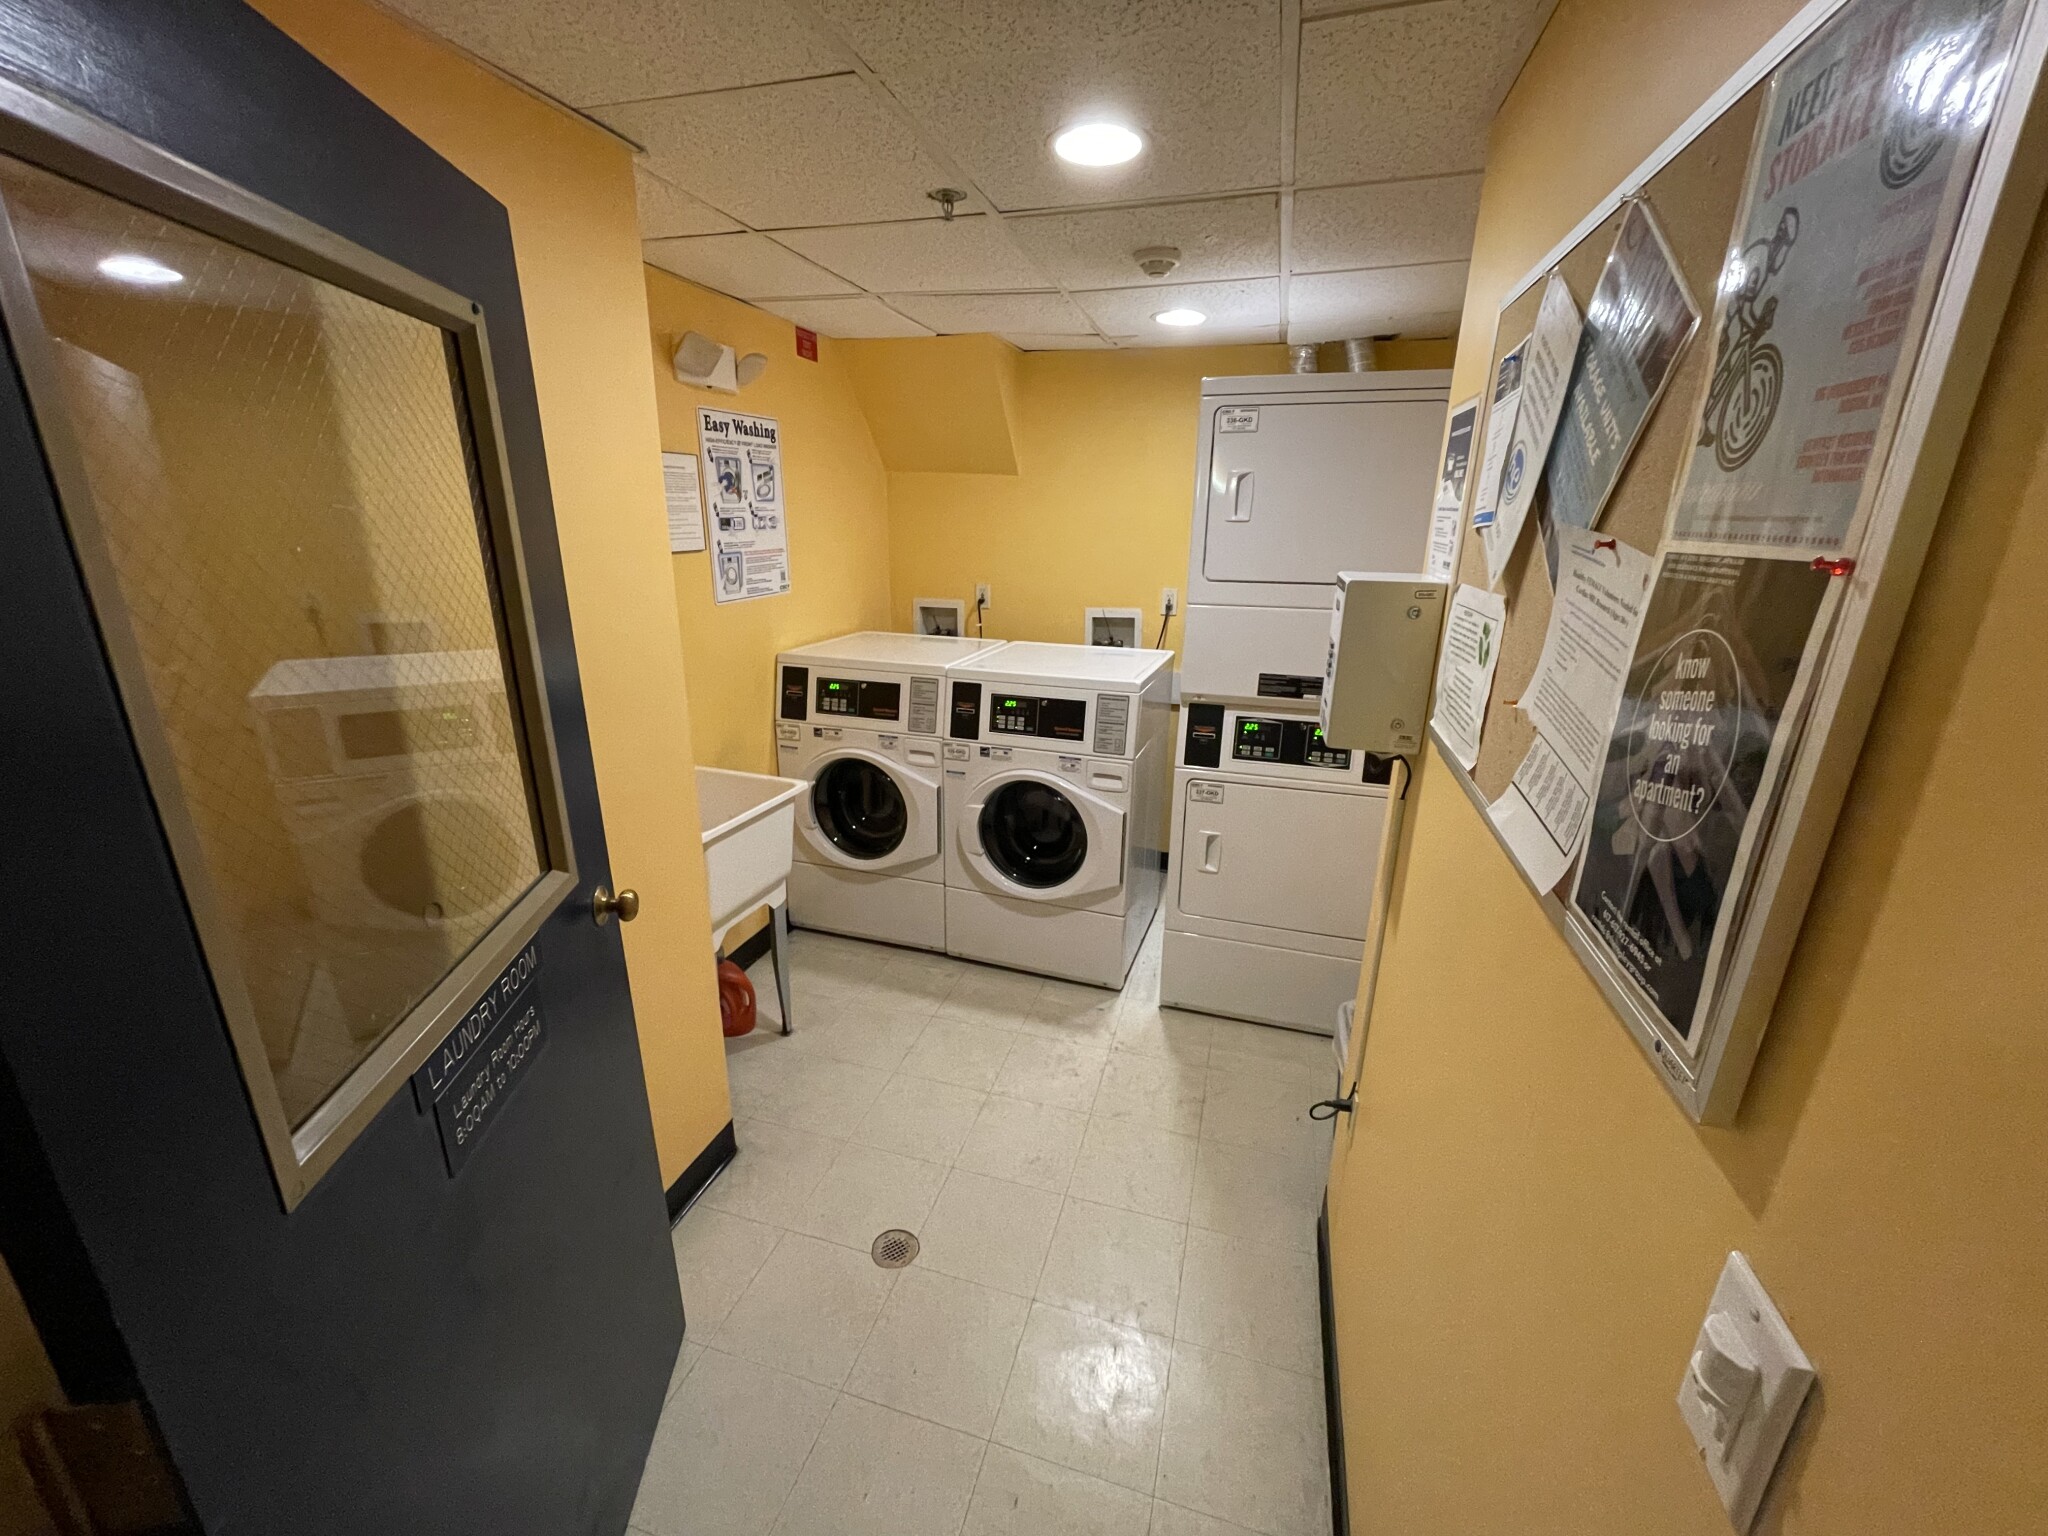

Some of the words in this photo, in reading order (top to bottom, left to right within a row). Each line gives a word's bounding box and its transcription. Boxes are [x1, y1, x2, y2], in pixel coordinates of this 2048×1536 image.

[703, 414, 730, 438] Easy
[732, 418, 777, 443] Washing
[1674, 652, 1711, 680] know
[1659, 690, 1715, 712] someone
[1648, 713, 1693, 749] looking
[1692, 717, 1715, 747] for
[1664, 753, 1681, 776] an
[1633, 773, 1705, 815] apartment?
[428, 989, 498, 1090] LAUNDRY
[500, 945, 537, 1002] ROOM
[452, 1064, 490, 1119] Laundry
[490, 1034, 514, 1069] Room
[513, 1004, 537, 1039] Hours
[496, 1072, 507, 1089] to
[506, 1019, 542, 1074] 10:00PM
